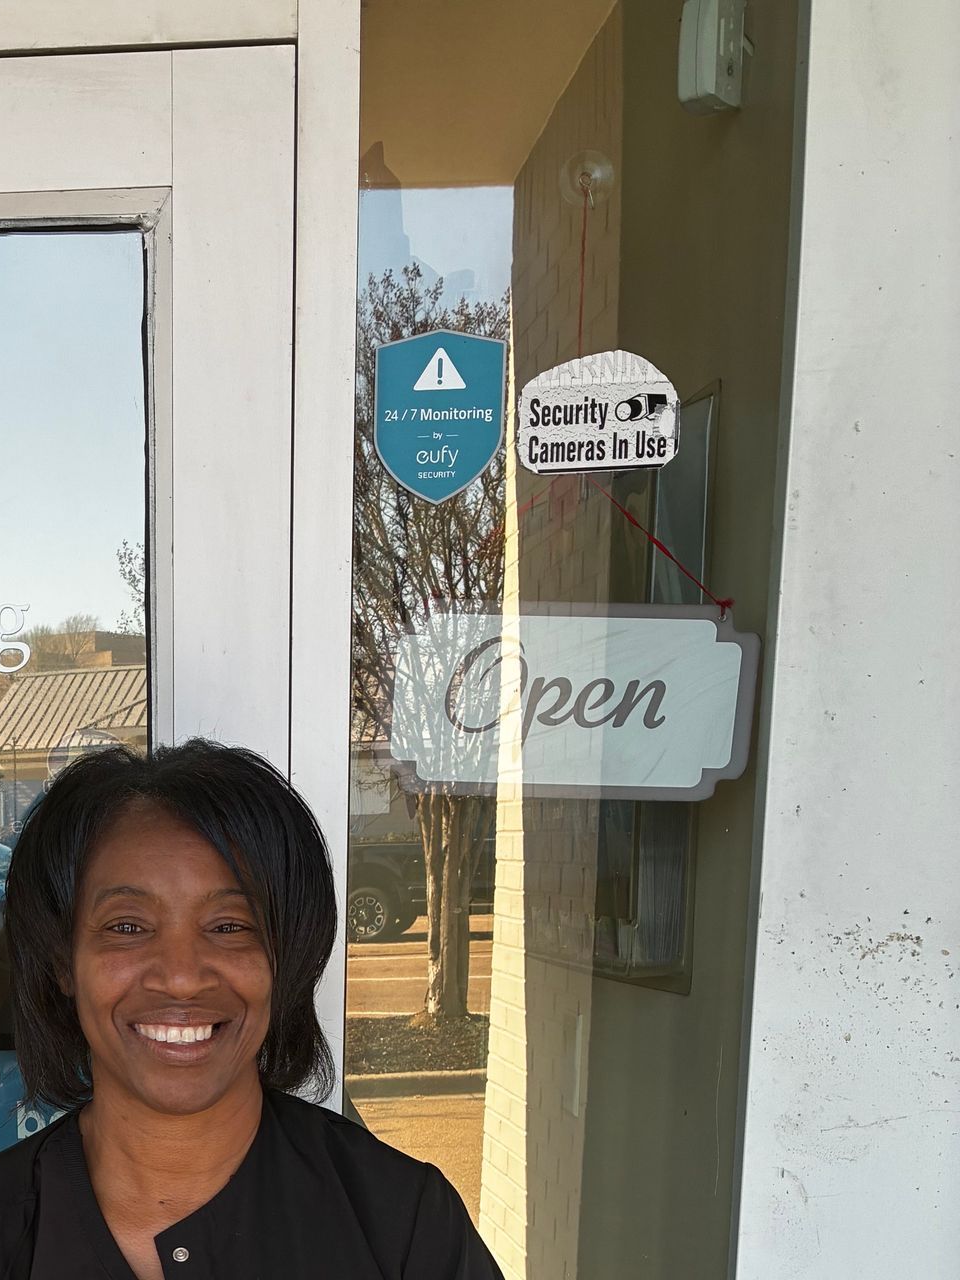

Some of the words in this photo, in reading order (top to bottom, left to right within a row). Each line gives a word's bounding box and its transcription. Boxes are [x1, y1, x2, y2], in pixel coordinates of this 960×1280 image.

[420, 406, 493, 422] Monitoring
[529, 397, 608, 430] Security
[432, 432, 443, 440] by
[528, 436, 606, 464] Cameras
[612, 432, 629, 460] In
[635, 430, 667, 459] Use
[416, 445, 459, 468] eufy
[417, 470, 456, 479] SECURITY
[444, 635, 667, 750] Open
